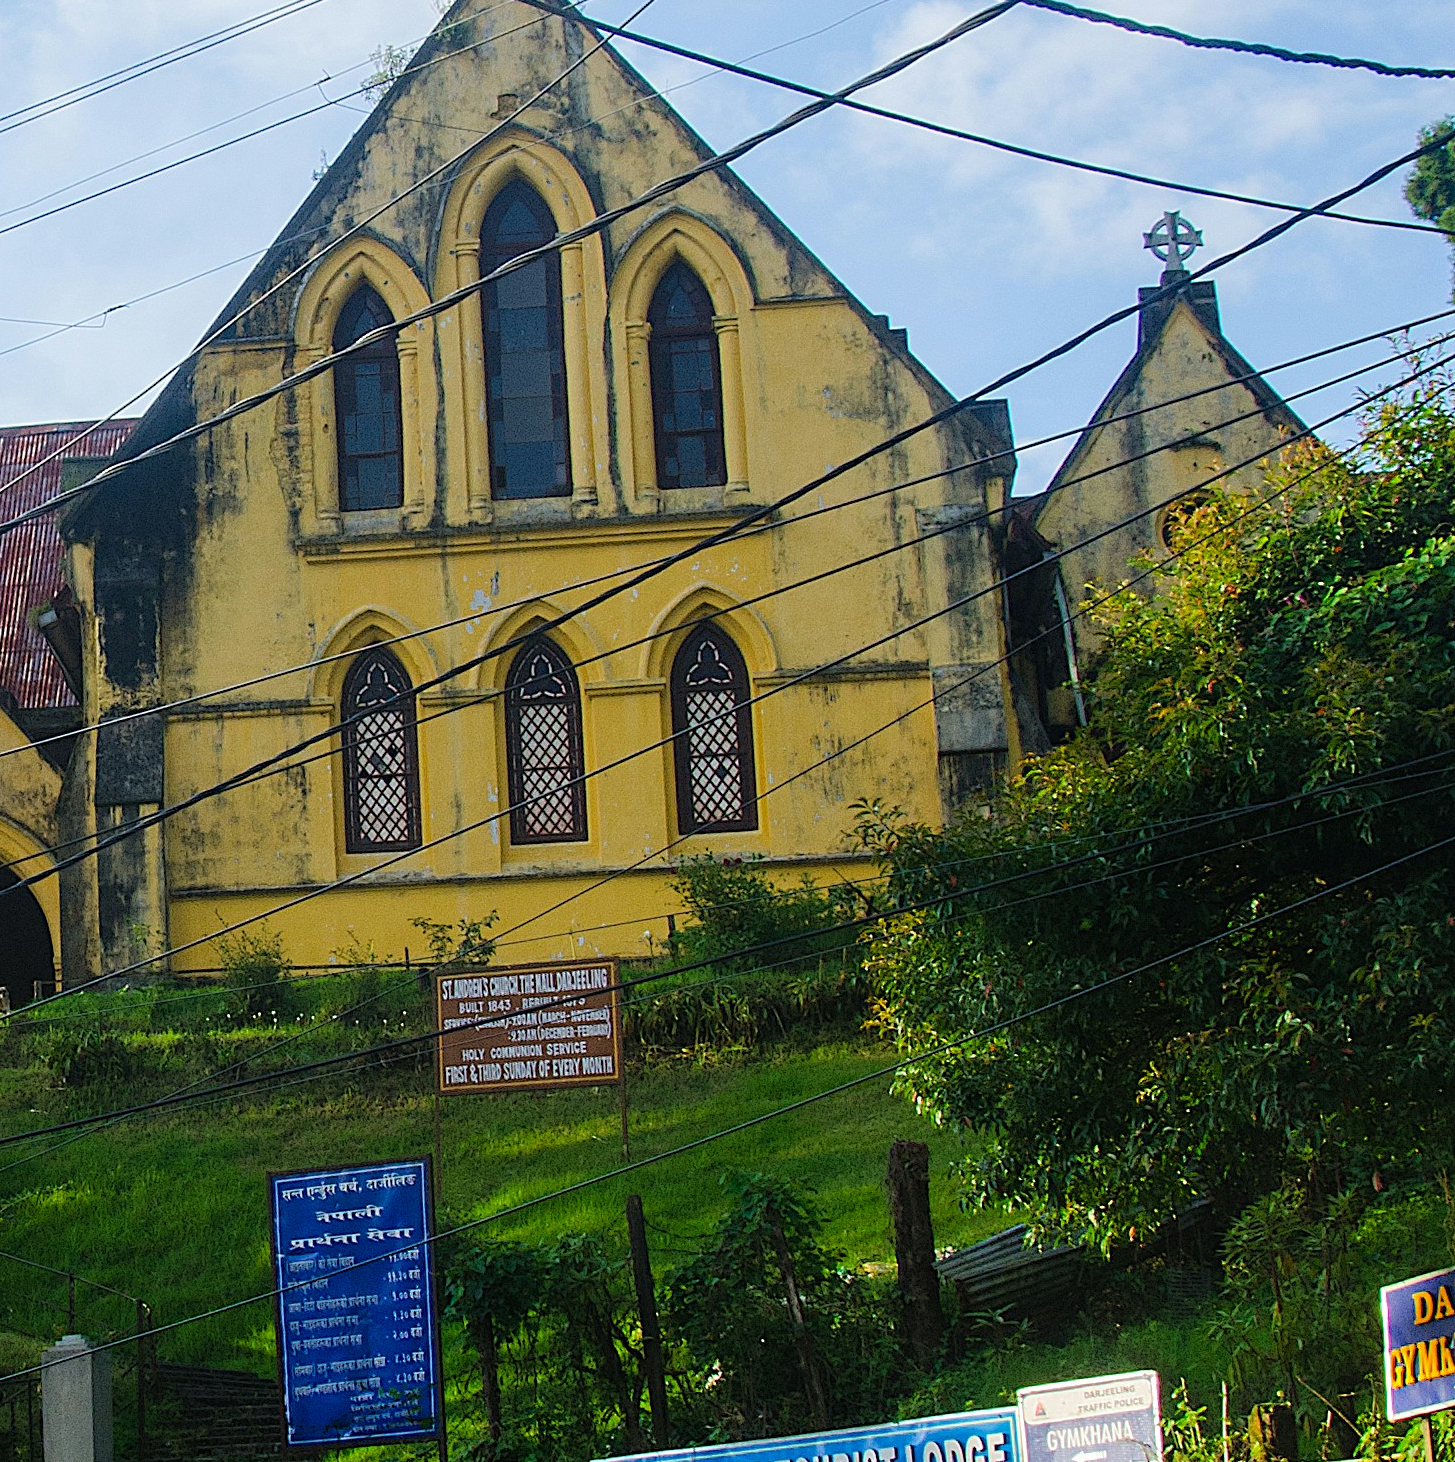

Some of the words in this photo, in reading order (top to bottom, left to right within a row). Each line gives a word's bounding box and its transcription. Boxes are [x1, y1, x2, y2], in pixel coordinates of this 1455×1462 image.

[556, 968, 608, 991] DARJEELING
[459, 1001, 484, 1014] BUILT
[487, 999, 512, 1013] 1843
[462, 1048, 485, 1062] HOLY
[490, 1045, 543, 1060] COMMUNION
[546, 1041, 587, 1057] SERVICE
[445, 1064, 468, 1085] FIRST
[478, 1063, 502, 1082] THIRD
[503, 1060, 538, 1080] SUNDAY
[538, 1060, 551, 1078] OF
[552, 1057, 582, 1077] EVERY
[582, 1055, 613, 1075] MONTH
[315, 1204, 384, 1223] नेपाली
[289, 1232, 361, 1251] प्रार्थना
[367, 1227, 414, 1242] सेवा
[1084, 1384, 1136, 1399] DARJEELING
[1078, 1400, 1113, 1414] TRAFFIC
[1114, 1397, 1144, 1409] POLICE
[1046, 1420, 1134, 1451] GYMKHANA
